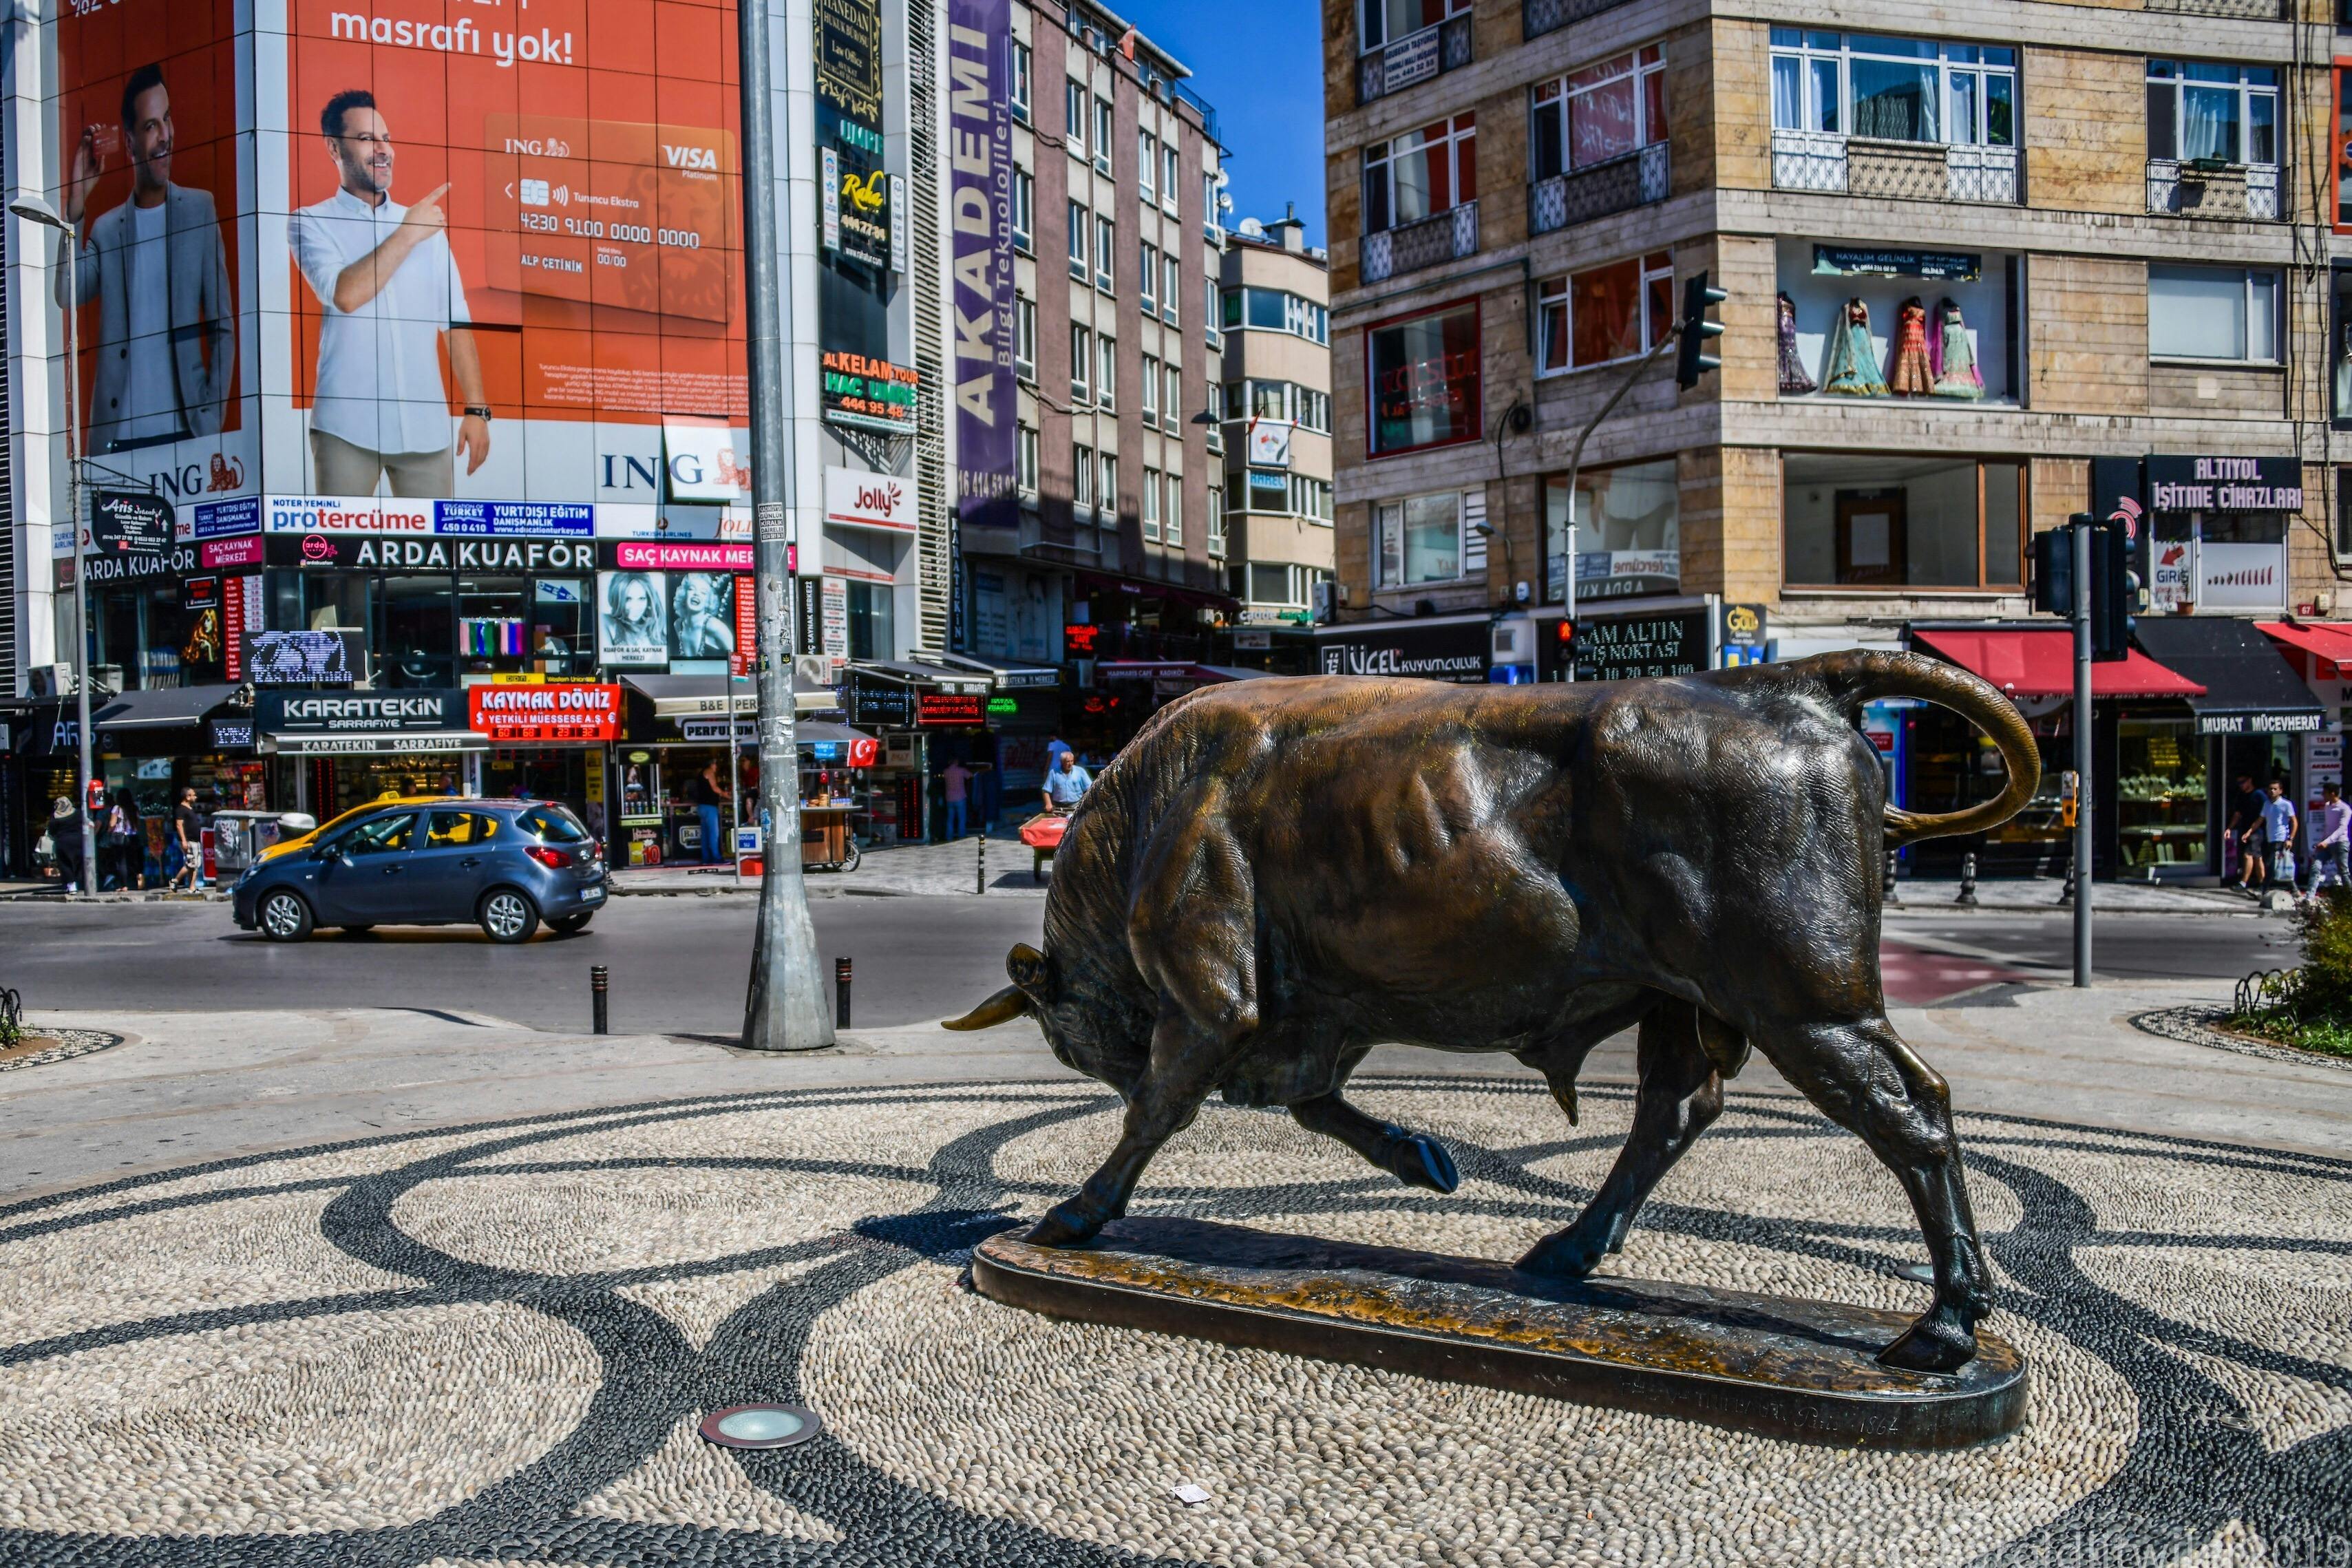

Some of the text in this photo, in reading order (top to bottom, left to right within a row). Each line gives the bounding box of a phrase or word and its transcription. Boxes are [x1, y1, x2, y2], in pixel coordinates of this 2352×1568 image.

[331, 12, 573, 67] masrafı yok!
[505, 138, 542, 156] ING
[661, 144, 717, 170] VISA
[681, 169, 718, 182] Platinum
[573, 191, 639, 209] Turuncu Ekstra
[520, 213, 700, 250] 4230 9100 0000 0000
[993, 100, 1015, 367] Bilgi Teknolojileri
[520, 254, 538, 267] ALP
[597, 254, 626, 268] 00/00
[1836, 252, 1916, 264] HAYALİM GELİNLİK
[894, 368, 919, 383] TOUR
[825, 372, 918, 407] HAC UMRE
[841, 396, 904, 418] 444 95 48
[600, 453, 703, 490] ING
[2194, 458, 2263, 480] ALTIYOL
[149, 464, 203, 499] ING
[273, 499, 302, 507] NOTER
[854, 485, 893, 518] Jolly
[2152, 480, 2302, 511] İŞİTME CİHAZLARI
[443, 506, 484, 517] TURKEY
[493, 505, 548, 519] YURTDIŞI
[273, 508, 426, 531] protercüme
[493, 517, 553, 527] DANIŞMANLIK
[761, 519, 783, 527] KİRALIK
[442, 522, 487, 533] 450 0 410
[493, 526, 589, 536] www.educationturkey.net
[712, 517, 752, 539] JOLL
[54, 531, 76, 541] TURKIS
[54, 540, 76, 549] AIRLIN
[209, 540, 253, 554] SAÇ KAYNAK
[215, 550, 247, 564] MERKEZİ
[356, 539, 593, 567] ARDA KUAFÖR
[624, 548, 657, 566] SAÇ
[660, 549, 721, 563] KAYNAK
[84, 557, 124, 581] ARDA
[129, 546, 195, 576] KUAFÖR
[2301, 605, 2311, 614] 67
[1401, 656, 1481, 672] KUYUMCULUK
[482, 687, 611, 710] KAYMAK DÖVİZ
[700, 701, 723, 711] B&E
[476, 712, 484, 725] $
[488, 712, 527, 724] YETKİLİ
[529, 712, 582, 723] MÜESSESE
[584, 714, 604, 725] A.Ş.
[2202, 714, 2320, 733] MURAT MÜCEVHERAT
[687, 725, 754, 737] PERFUUM
[301, 738, 462, 752] KARATEKİN SARRAFİYE
